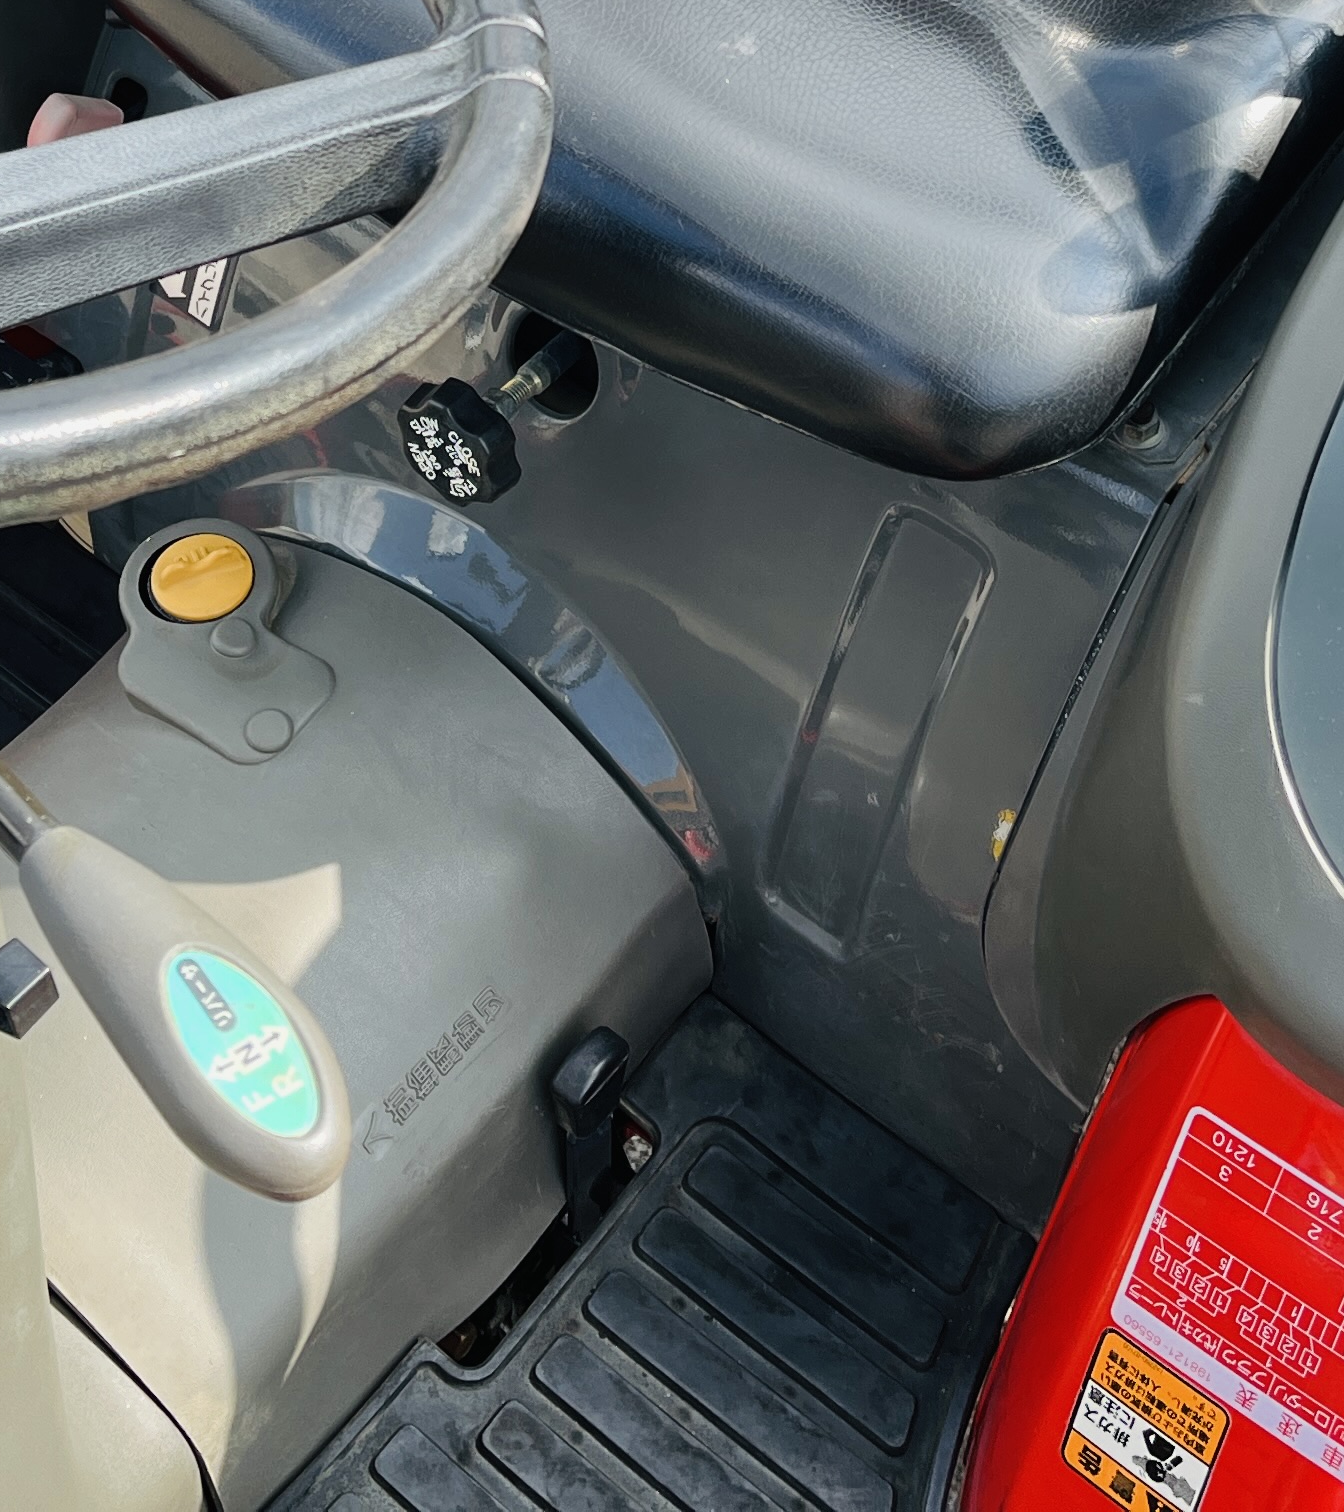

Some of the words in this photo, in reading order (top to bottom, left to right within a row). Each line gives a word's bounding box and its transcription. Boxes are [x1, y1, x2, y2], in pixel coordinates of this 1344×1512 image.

[407, 441, 437, 480] OPEN
[447, 430, 481, 477] CLOSE
[180, 962, 234, 1029] リバーサ
[270, 1064, 305, 1094] R
[240, 1085, 277, 1114] F
[1212, 1130, 1256, 1169] 1210
[1218, 1165, 1233, 1182] 3
[1306, 1191, 1344, 1225] 716
[1307, 1222, 1323, 1241] 2
[1128, 1283, 1180, 1326] トレーラ
[1083, 1403, 1131, 1448] 排ガス
[1273, 1385, 1331, 1429] ロータリ
